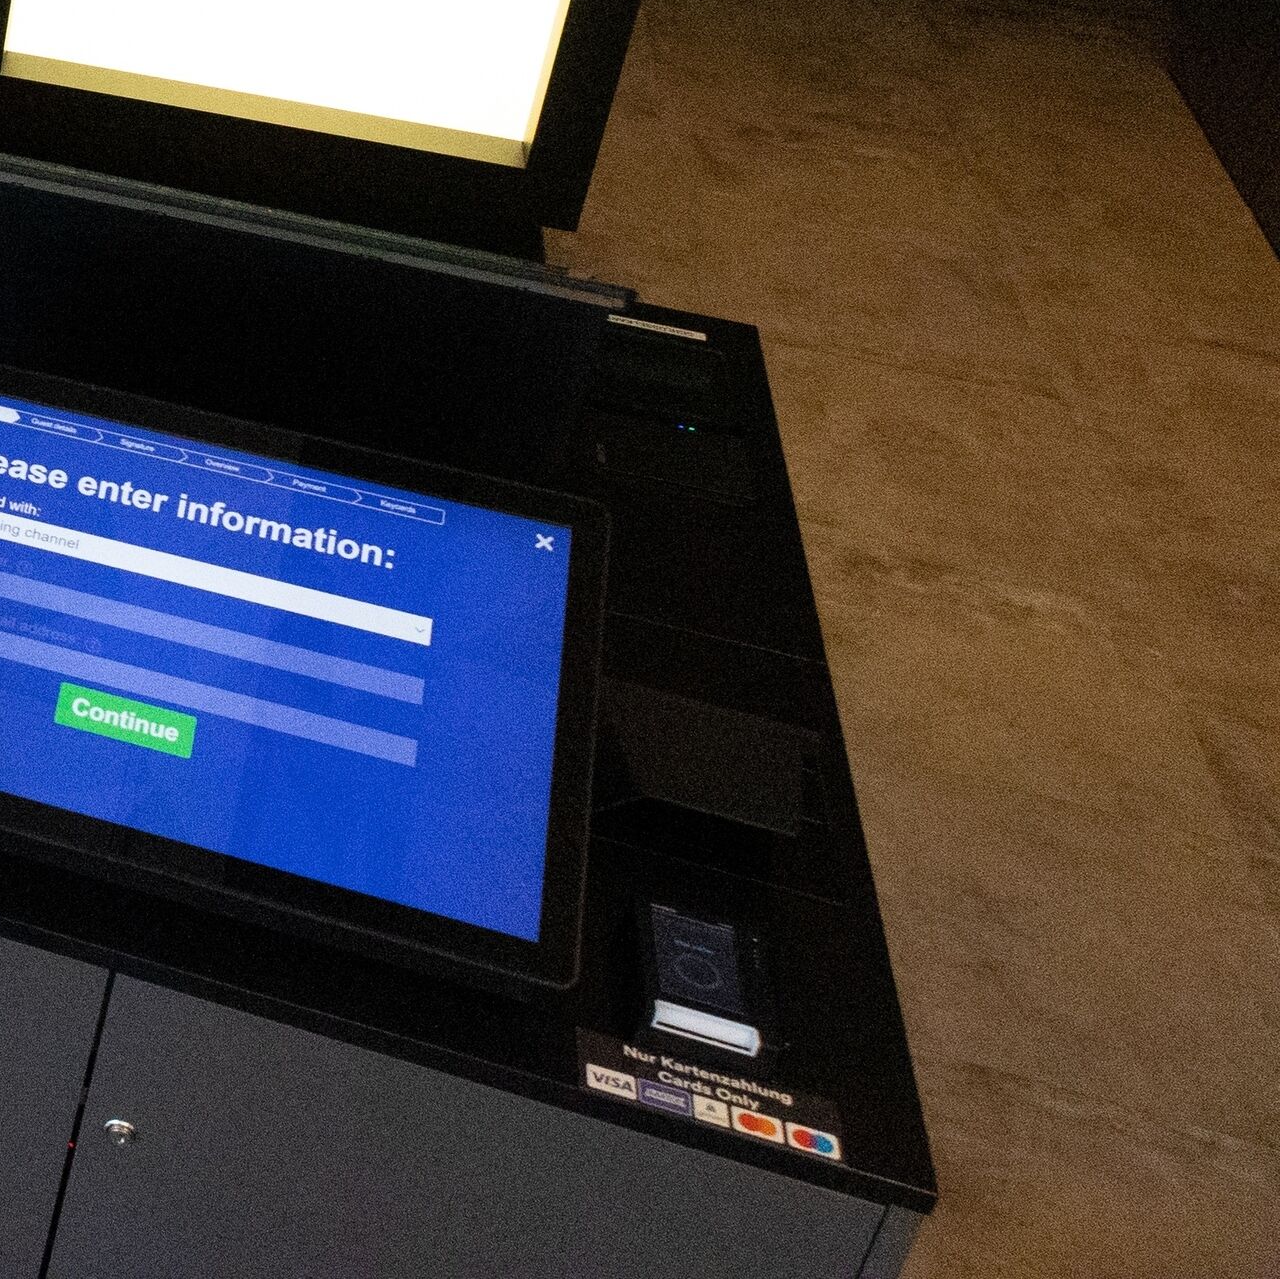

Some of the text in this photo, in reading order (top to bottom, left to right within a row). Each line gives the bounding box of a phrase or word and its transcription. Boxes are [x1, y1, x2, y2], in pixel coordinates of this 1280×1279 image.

[292, 478, 327, 495] Payment
[9, 498, 42, 517] with:
[77, 474, 169, 513] enter
[176, 494, 396, 570] information:
[24, 528, 81, 549] channel
[71, 697, 180, 743] Continue
[593, 1071, 634, 1092] VISA
[623, 1045, 657, 1063] Nur
[661, 1055, 794, 1106] Kartenzahlung
[657, 1070, 713, 1096] Cards
[715, 1085, 760, 1111] Only
